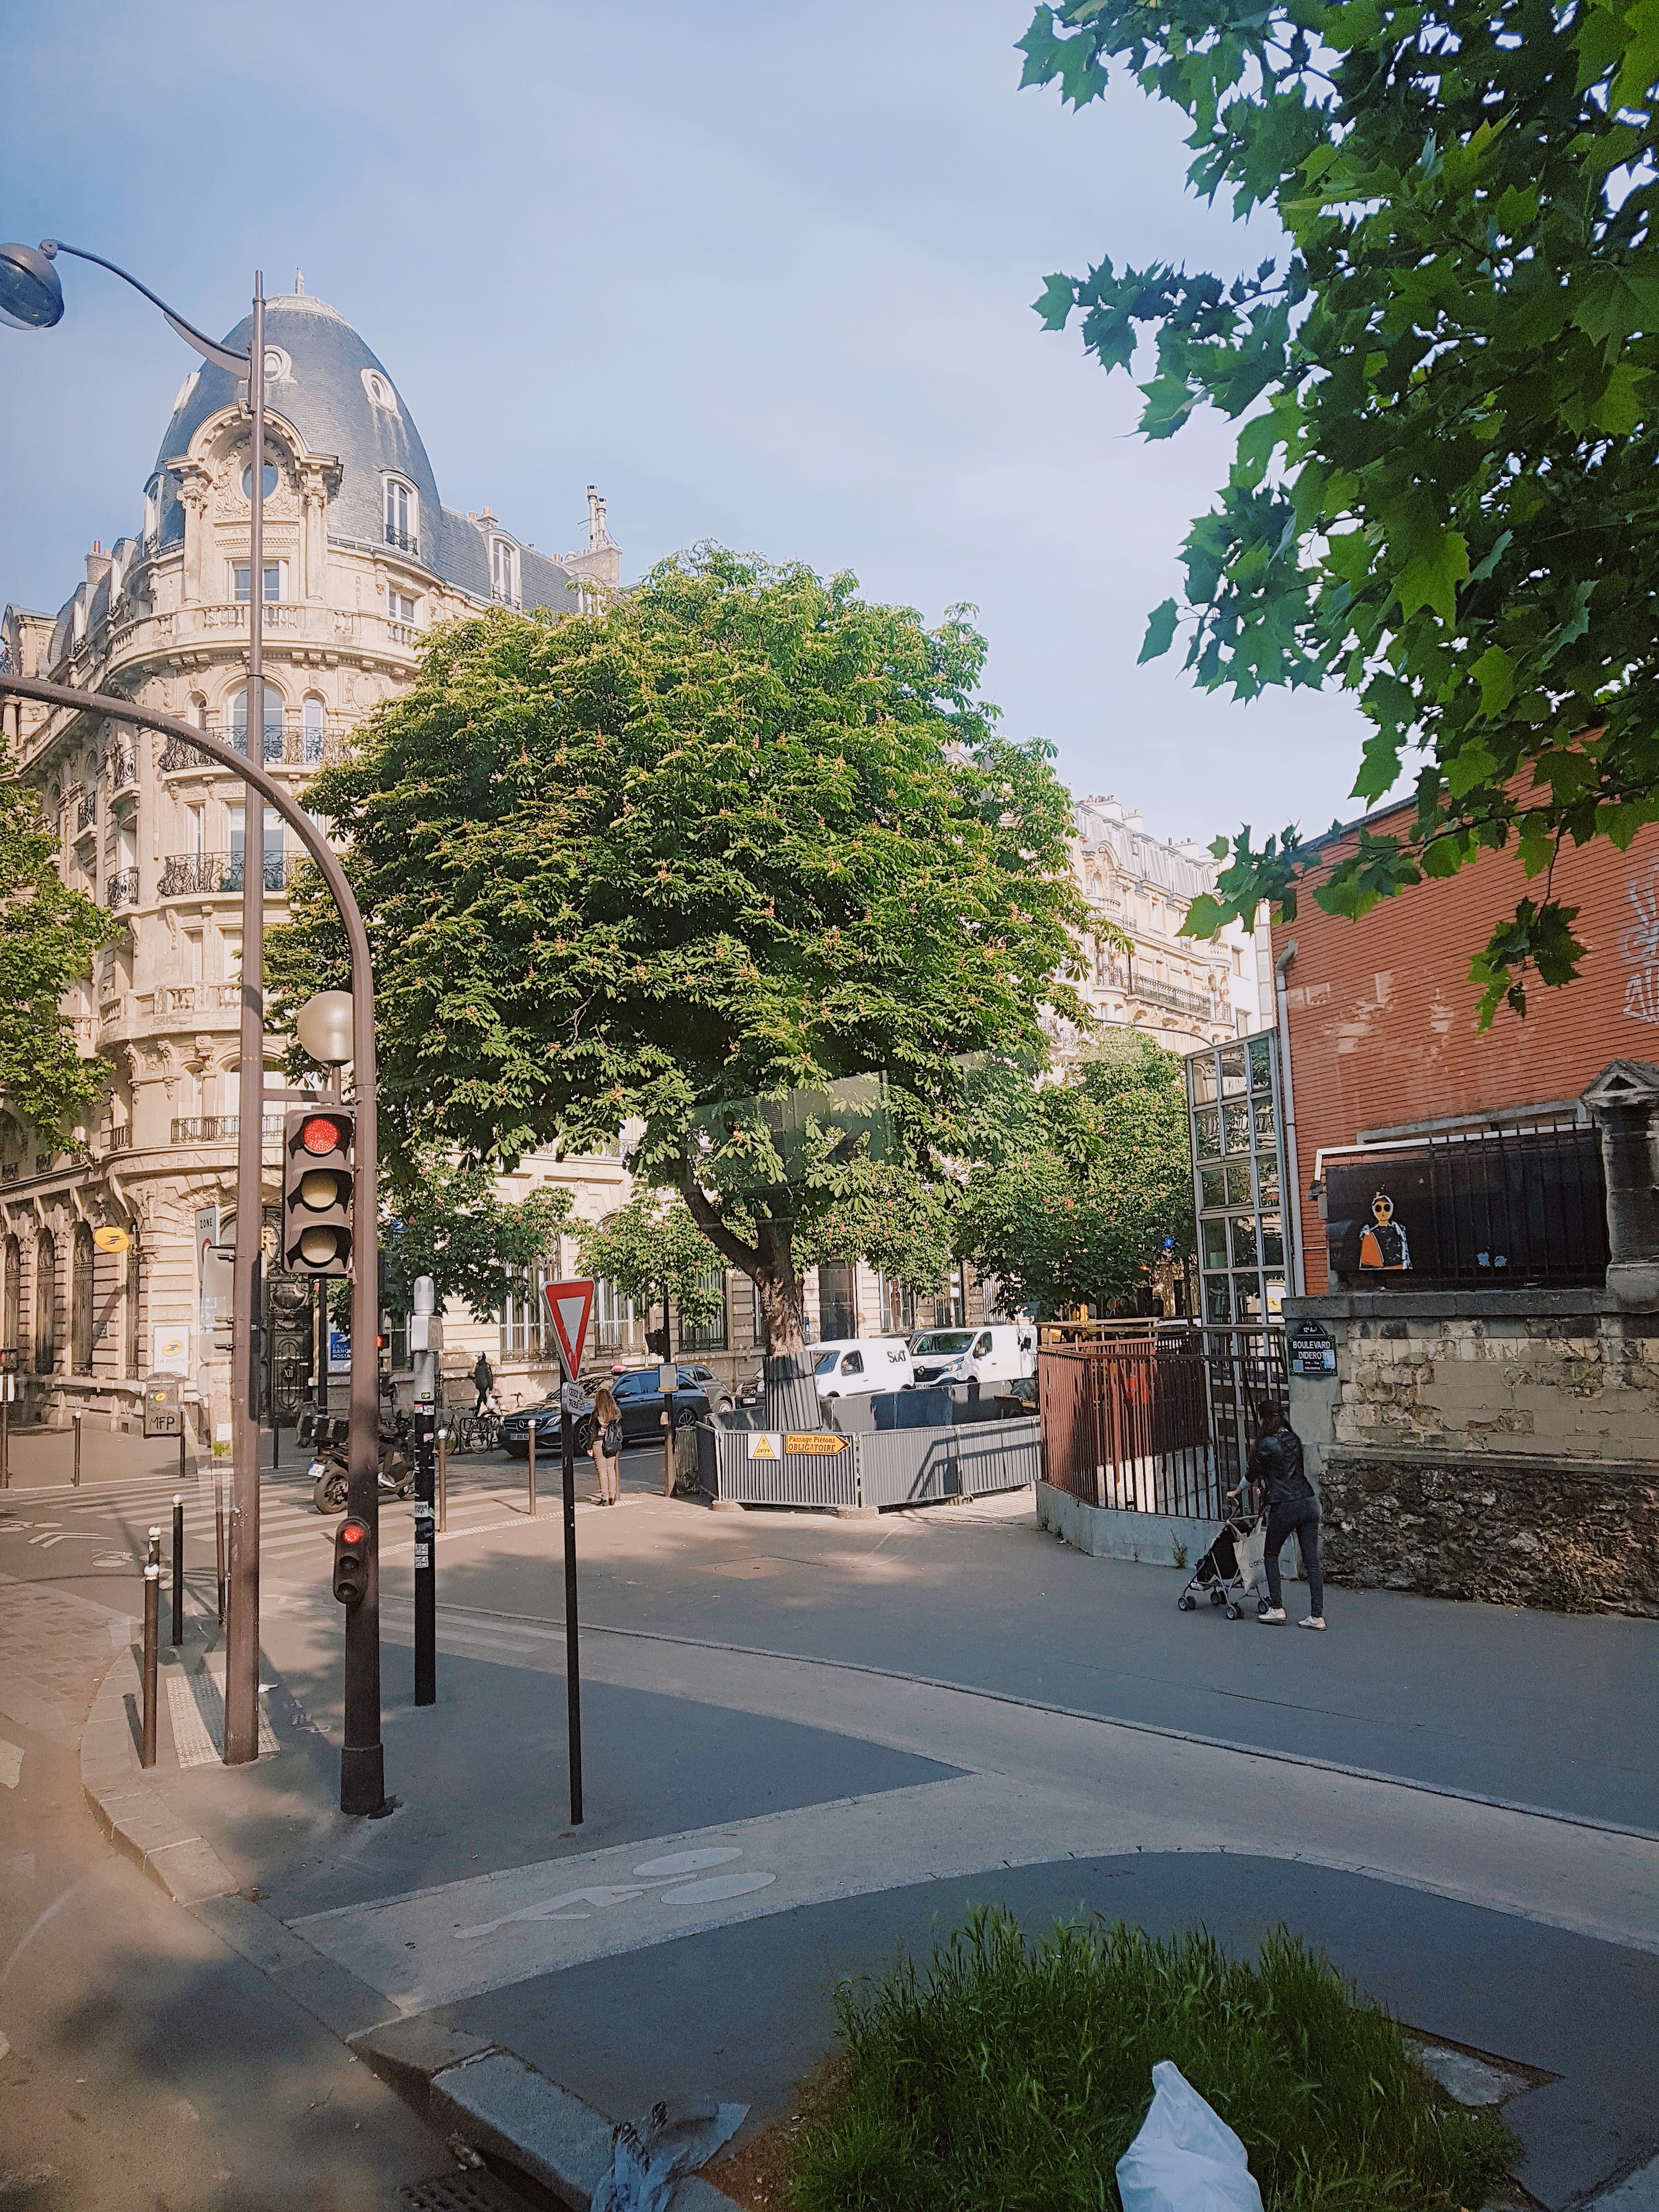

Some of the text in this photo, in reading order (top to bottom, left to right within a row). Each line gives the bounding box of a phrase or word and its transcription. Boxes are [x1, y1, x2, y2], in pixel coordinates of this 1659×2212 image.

[200, 1217, 212, 1229] ZONE
[1293, 1341, 1331, 1349] BOULEVARD
[149, 1416, 175, 1431] MFP
[788, 1436, 812, 1446] Passage
[788, 1443, 836, 1452] OBLIGATOIRE
